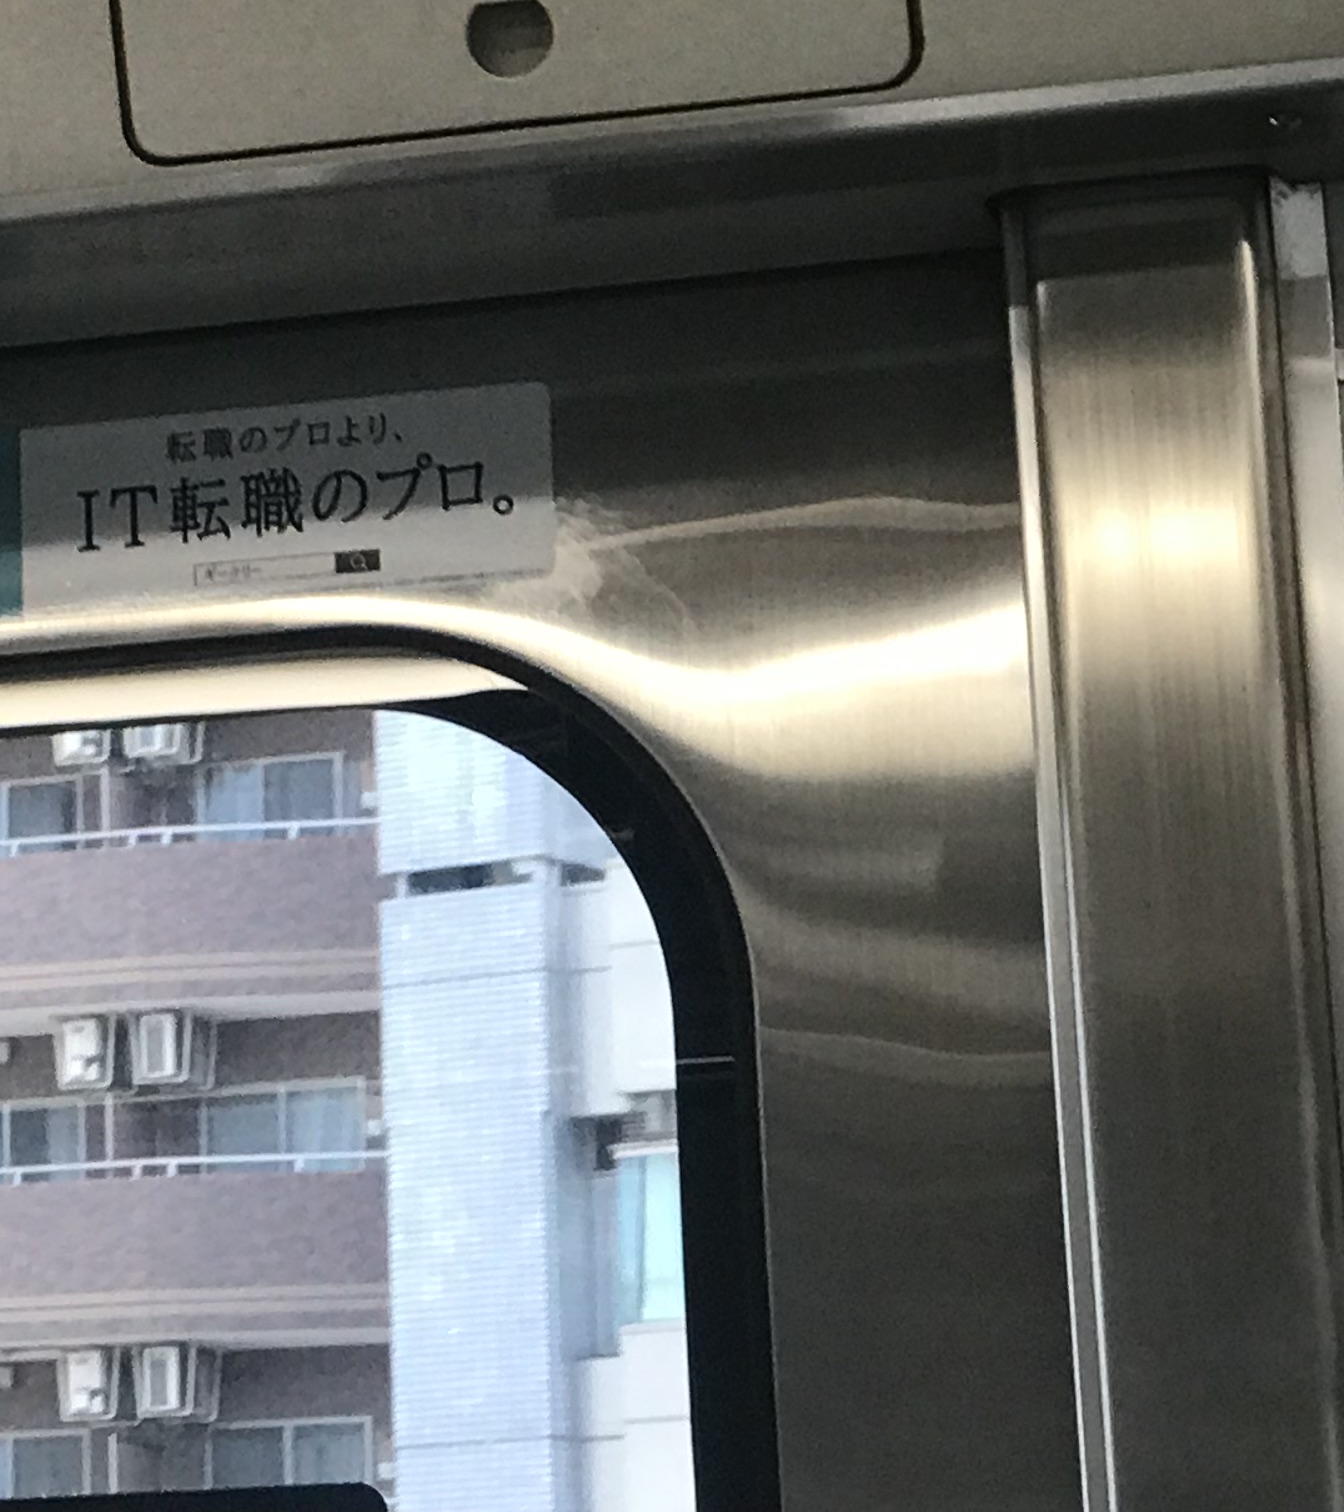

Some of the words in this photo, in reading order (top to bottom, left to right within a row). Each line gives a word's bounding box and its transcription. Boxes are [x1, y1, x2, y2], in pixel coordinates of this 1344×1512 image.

[164, 411, 404, 465] 転職のプロより、
[75, 451, 516, 554] IT転職のプロ。
